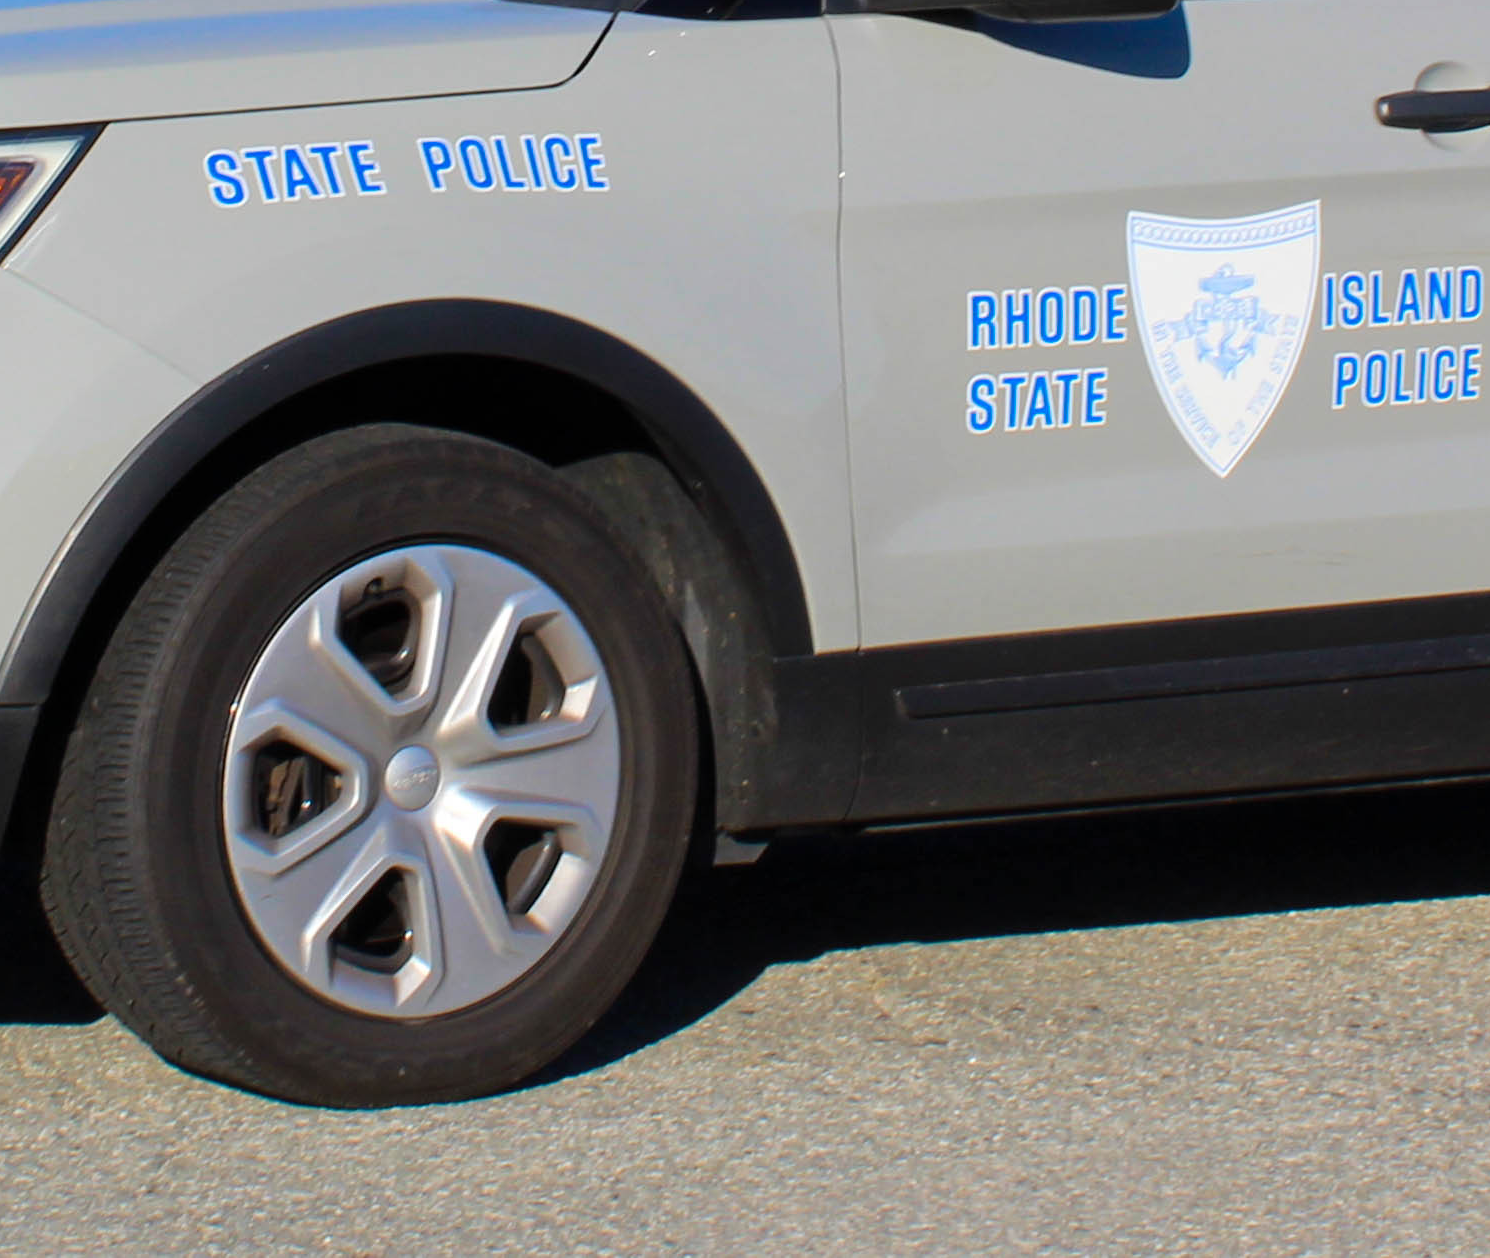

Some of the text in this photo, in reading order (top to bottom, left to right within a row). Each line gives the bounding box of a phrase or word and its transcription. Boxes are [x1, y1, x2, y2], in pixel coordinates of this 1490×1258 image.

[204, 133, 610, 207] STATE POLICE
[967, 266, 1484, 350] RHODE ISLAND
[966, 344, 1482, 434] STATE POLICE
